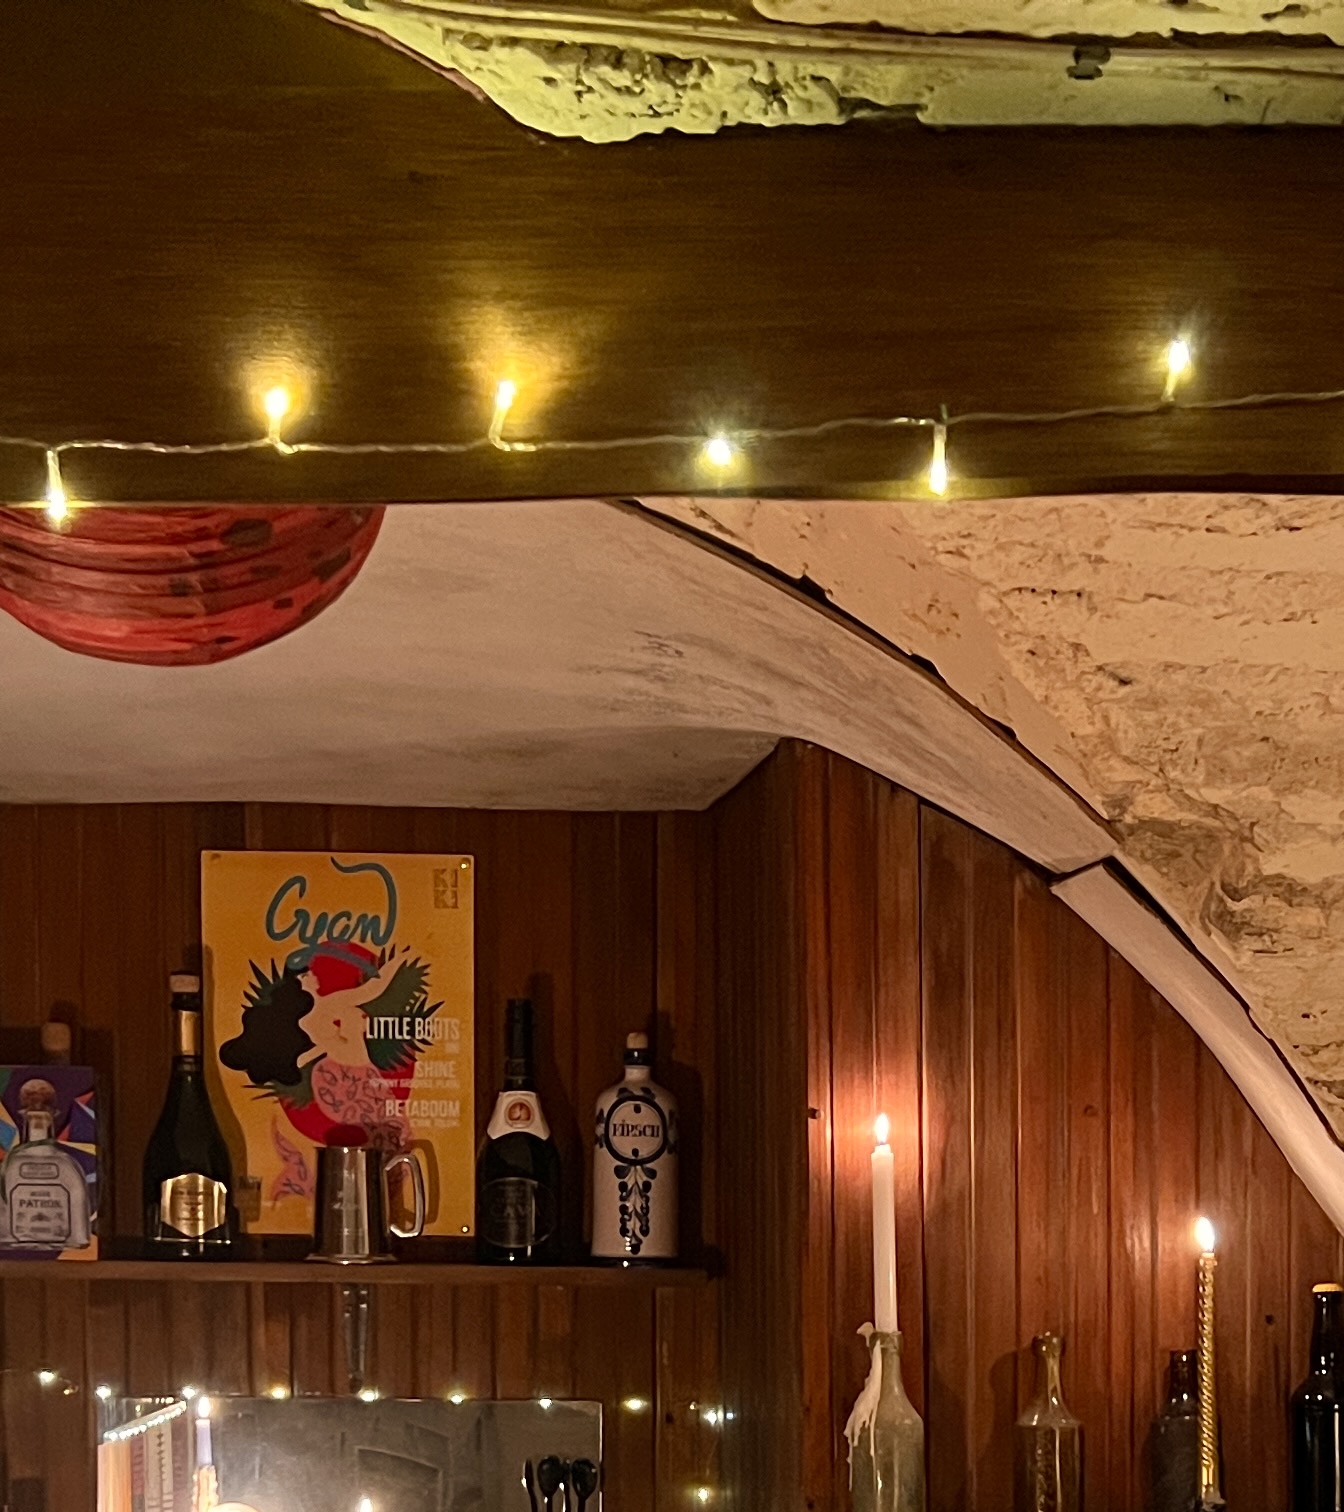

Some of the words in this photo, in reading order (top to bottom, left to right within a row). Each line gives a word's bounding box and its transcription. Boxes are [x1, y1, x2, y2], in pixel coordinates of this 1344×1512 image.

[366, 1016, 412, 1040] LITTLE
[415, 1017, 460, 1041] BOOTS
[416, 1061, 457, 1078] SHINE
